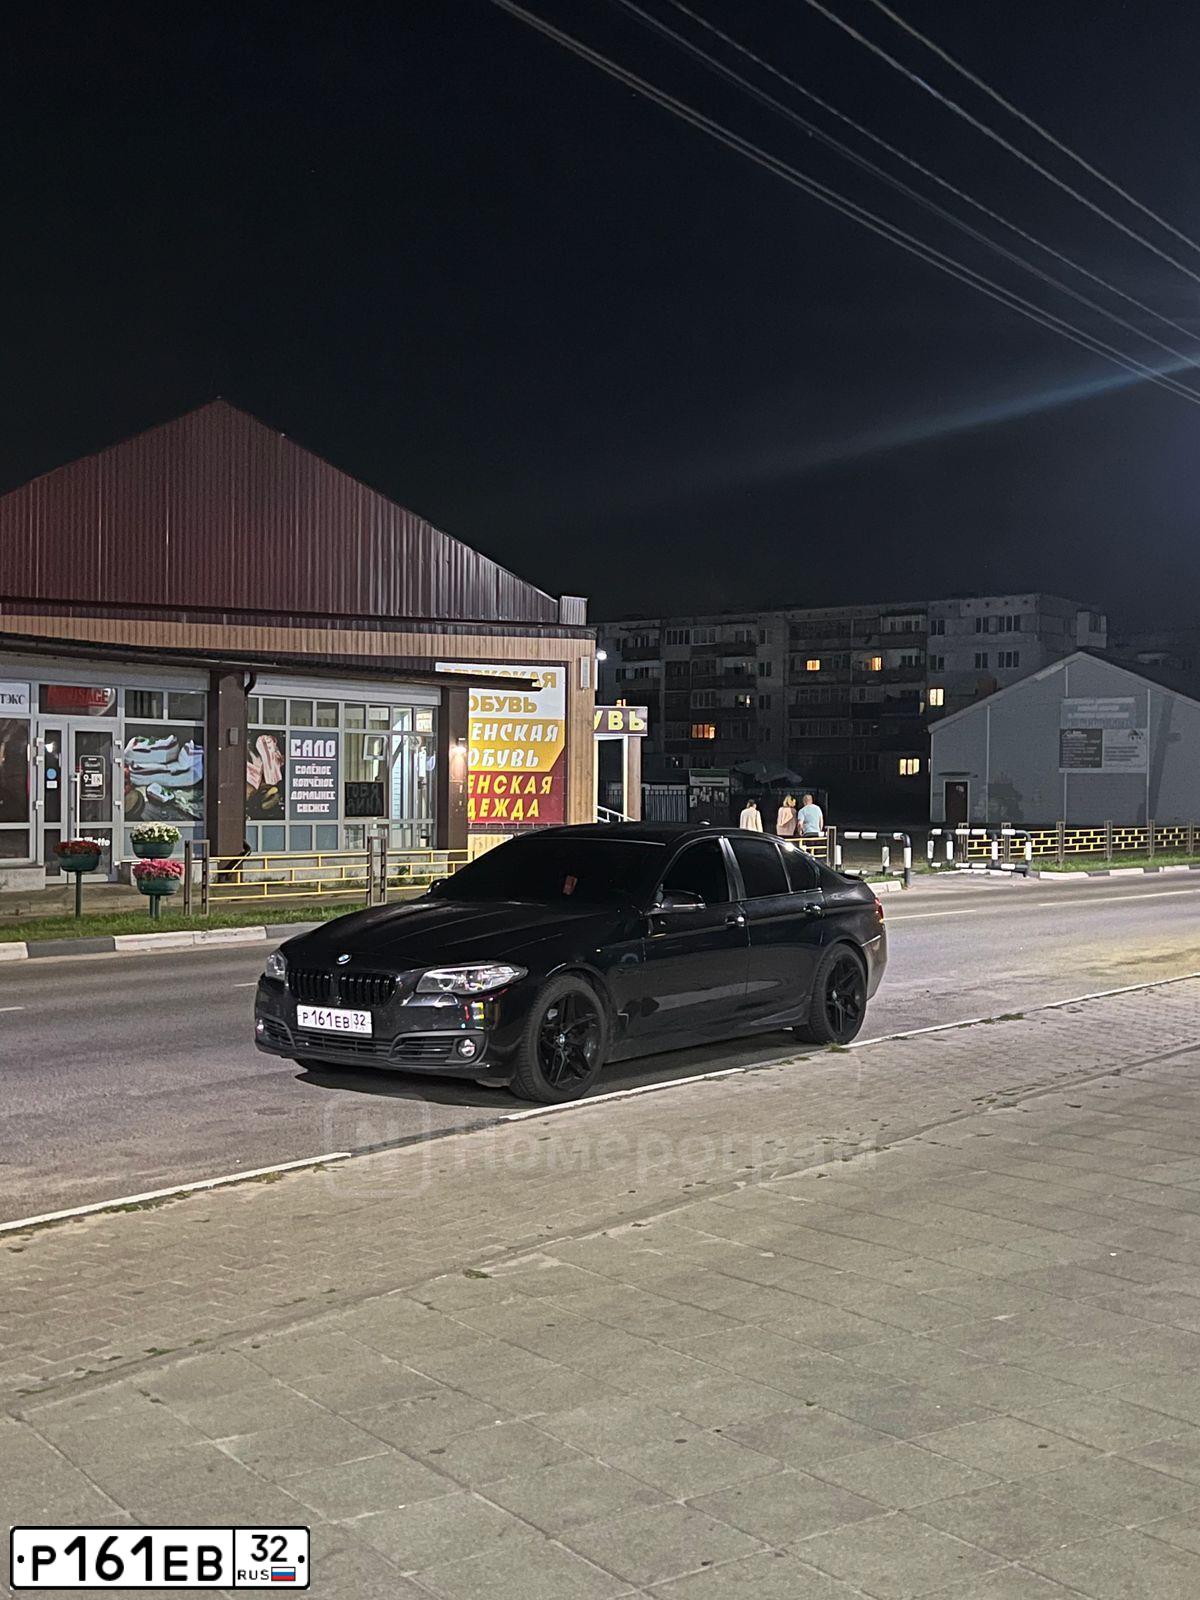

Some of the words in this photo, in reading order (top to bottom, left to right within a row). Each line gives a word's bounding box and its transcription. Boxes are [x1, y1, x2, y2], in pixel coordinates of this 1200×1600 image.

[290, 739, 336, 757] САЛО
[468, 747, 539, 768] ОБУВЬ
[303, 1010, 350, 1028] Р161ЕВ
[353, 1014, 366, 1026] 32
